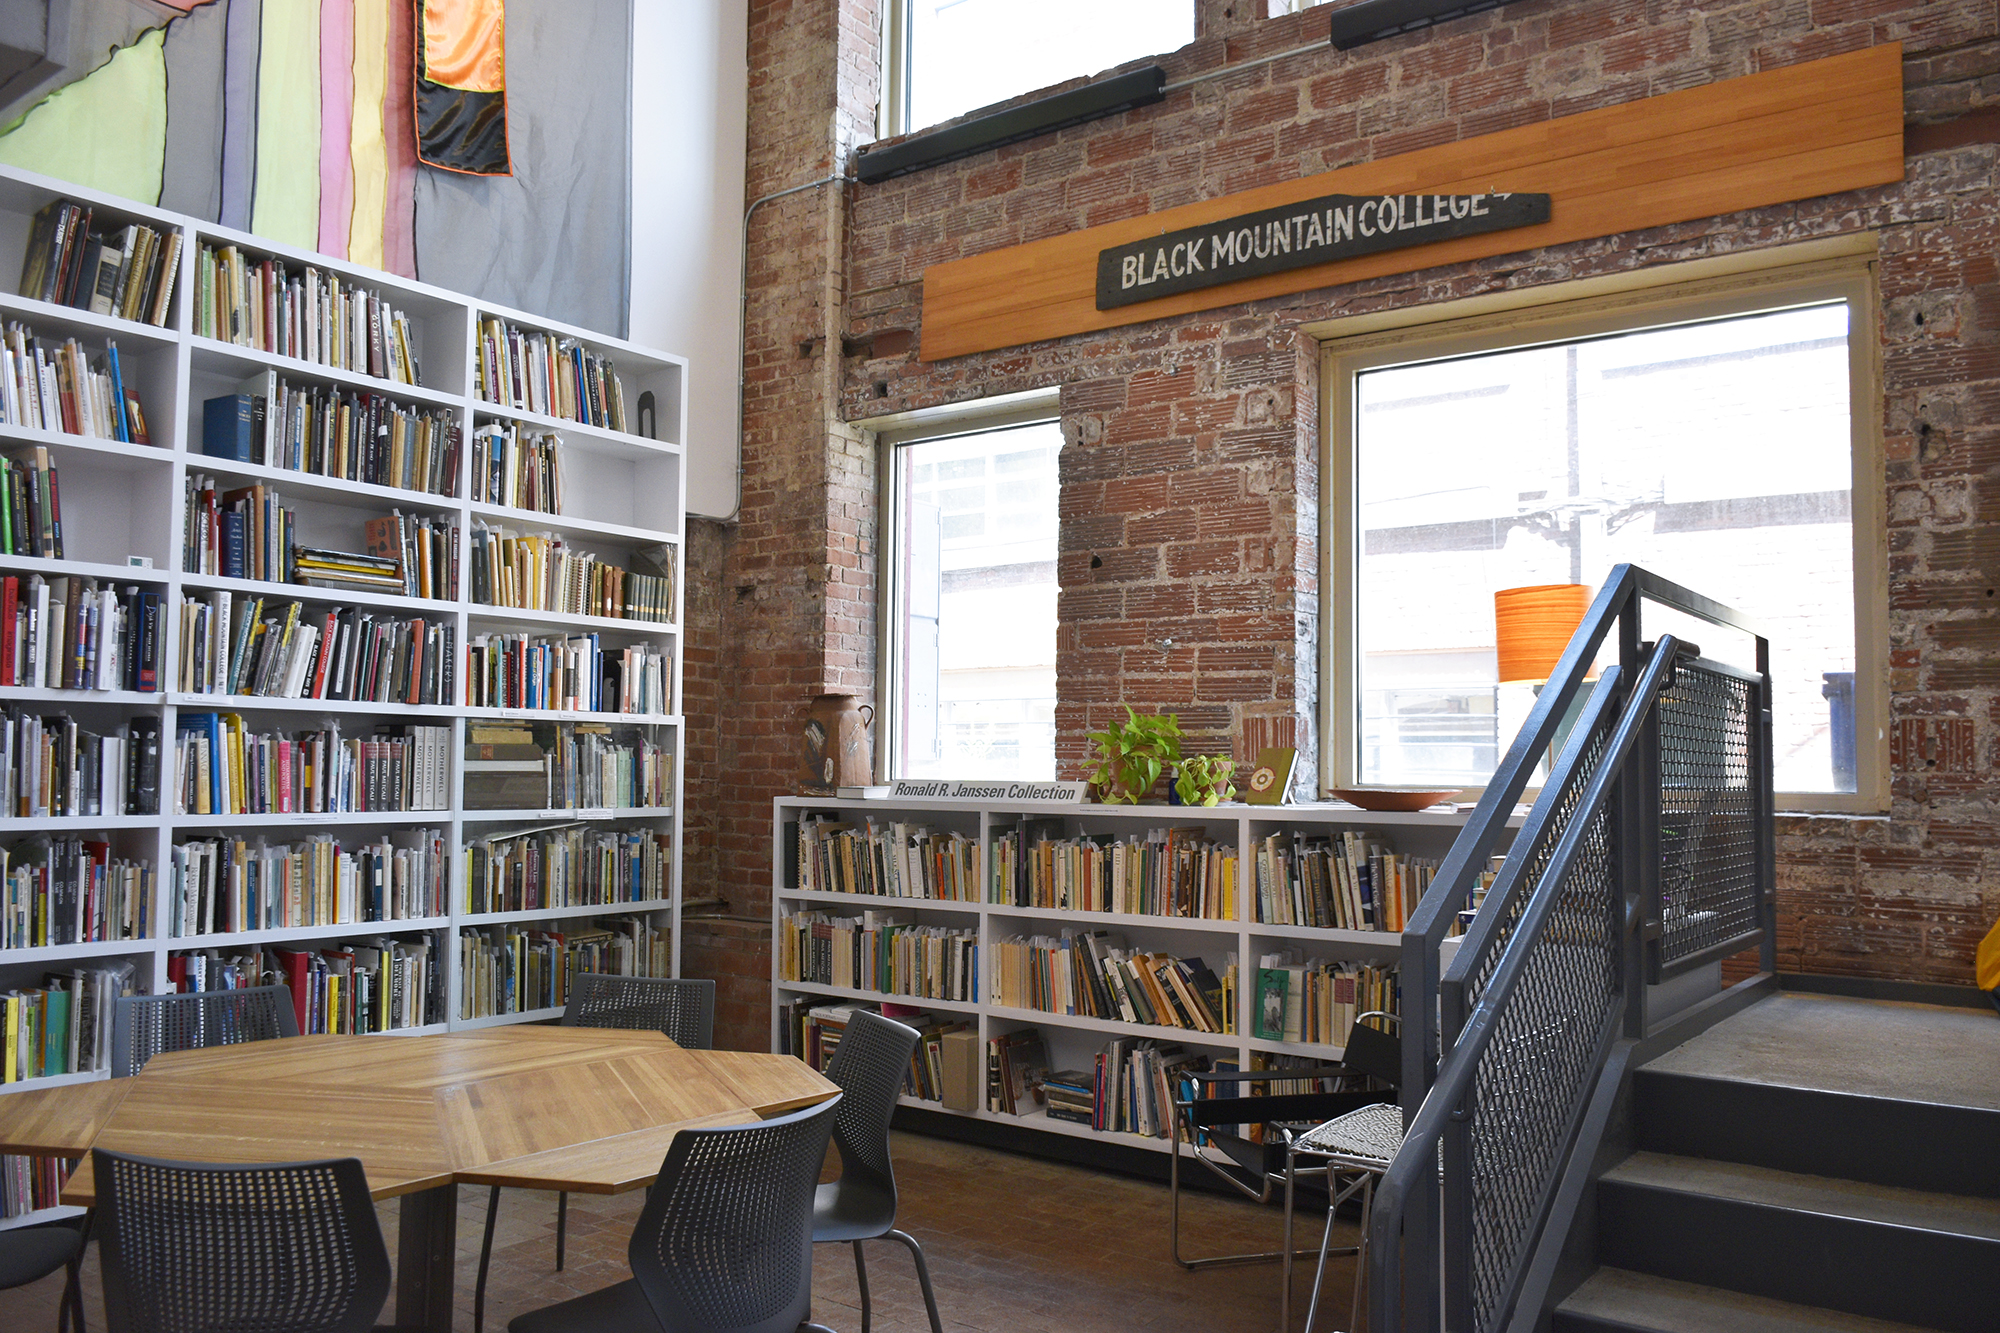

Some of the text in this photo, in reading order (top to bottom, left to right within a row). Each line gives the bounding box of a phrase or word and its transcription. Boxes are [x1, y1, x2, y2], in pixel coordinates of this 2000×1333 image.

[131, 228, 149, 284] MICHELANGELO
[1121, 194, 1490, 290] BLACK MOUNTAIN COLLEGE
[7, 588, 15, 620] bauhaus
[234, 611, 252, 678] BLACK MOUNTAIN COLLEGE
[444, 641, 453, 683] MAKERS
[307, 658, 316, 677] MOUNTAIN
[895, 782, 1076, 800] Ronald R. Janssen Collection
